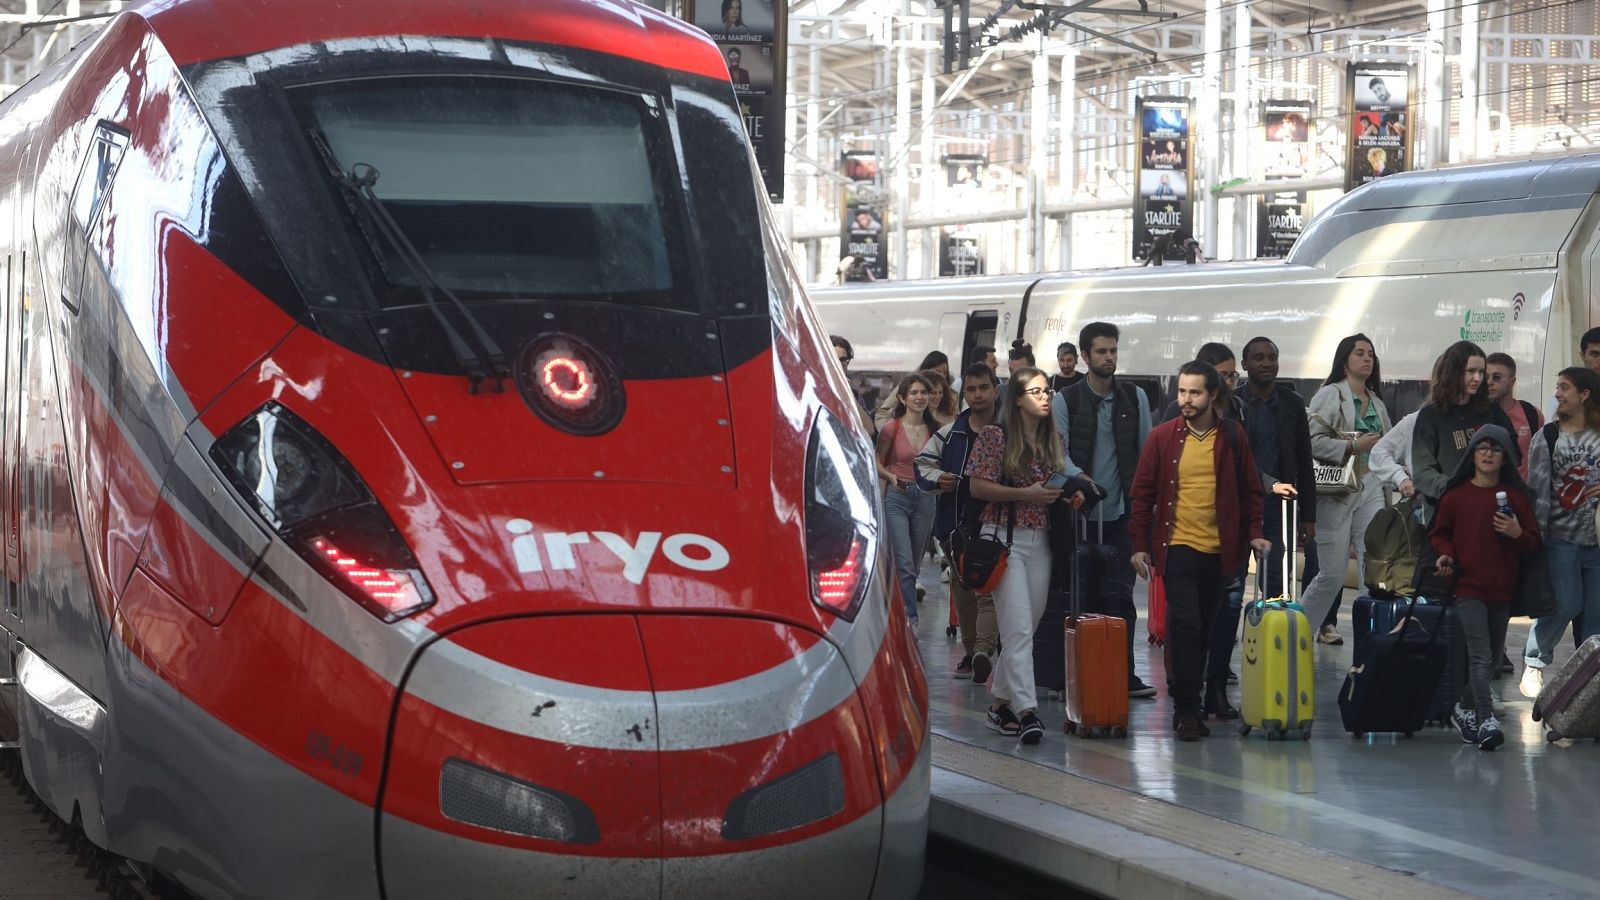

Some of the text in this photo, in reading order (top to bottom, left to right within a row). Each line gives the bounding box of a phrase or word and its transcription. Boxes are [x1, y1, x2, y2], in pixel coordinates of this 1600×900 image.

[728, 32, 762, 42] MARTÍNEZ
[1145, 211, 1181, 226] STARLITE
[1269, 215, 1303, 230] STARLITE
[1471, 309, 1506, 323] transporte
[1044, 312, 1066, 337] renfe
[1469, 325, 1503, 342] sostenible
[1569, 444, 1593, 453] THE
[505, 518, 730, 585] iryo
